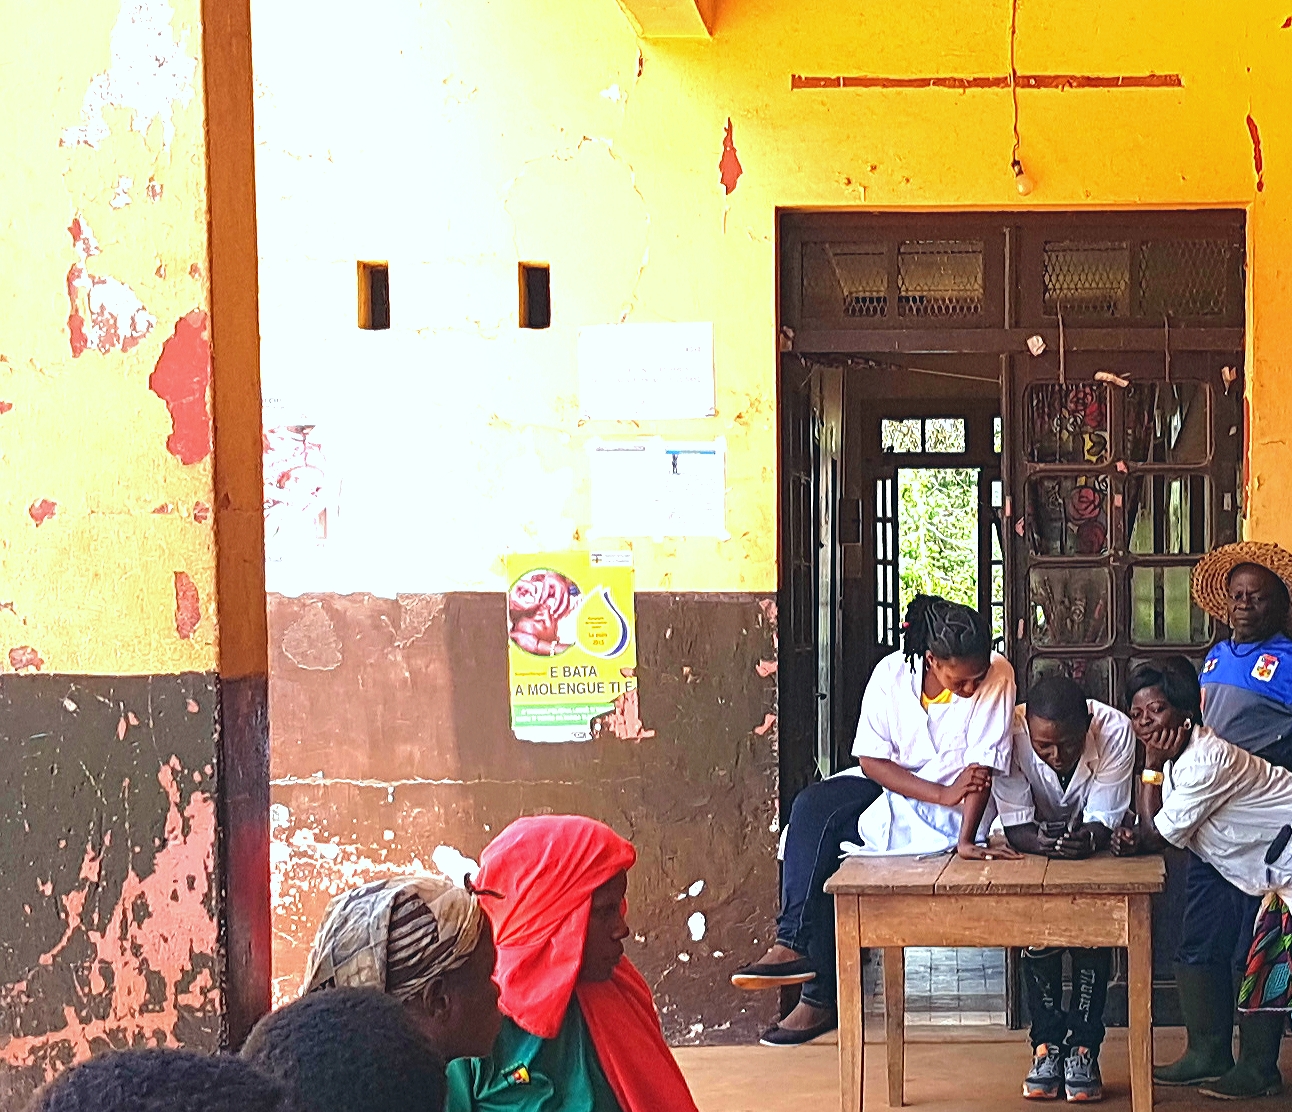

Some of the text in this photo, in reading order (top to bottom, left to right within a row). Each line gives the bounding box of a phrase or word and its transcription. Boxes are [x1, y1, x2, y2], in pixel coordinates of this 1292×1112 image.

[550, 666, 558, 678] E
[563, 665, 598, 678] BATA
[515, 684, 524, 696] A
[528, 682, 605, 696] MOLENGUE
[609, 681, 620, 693] TI
